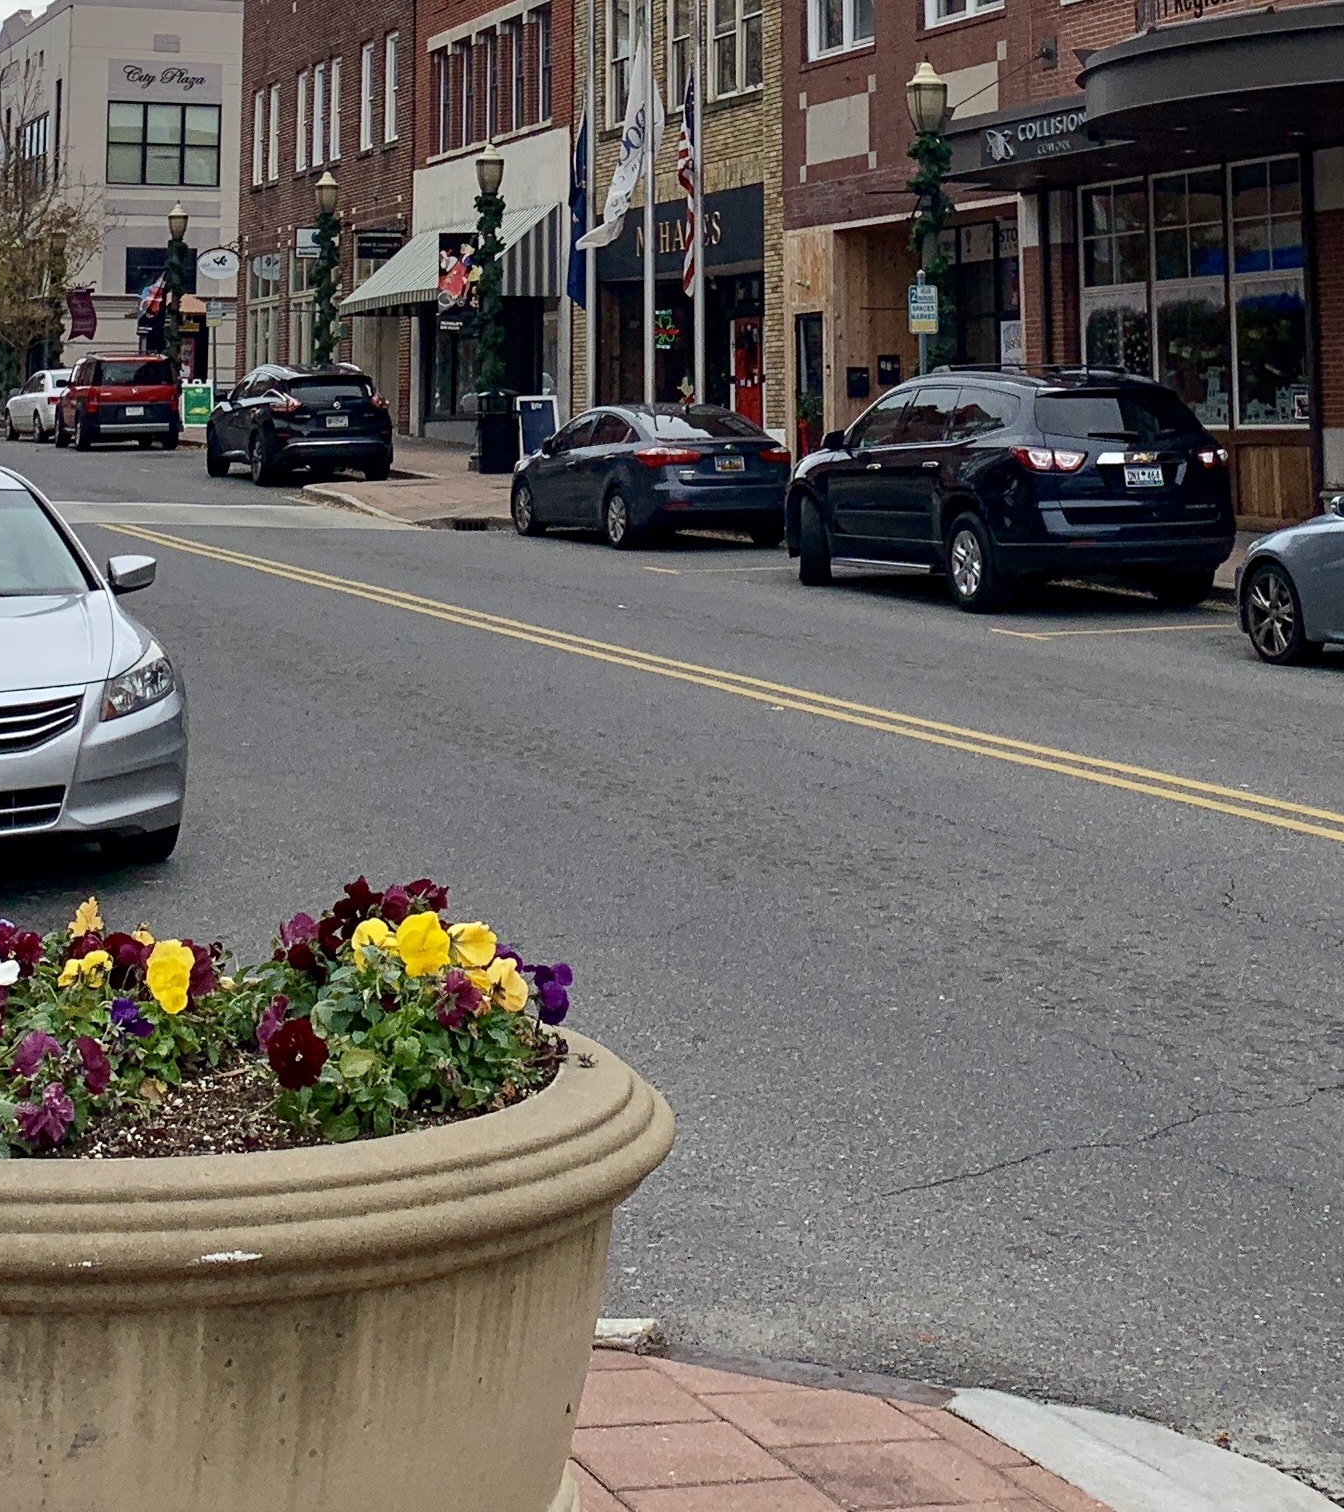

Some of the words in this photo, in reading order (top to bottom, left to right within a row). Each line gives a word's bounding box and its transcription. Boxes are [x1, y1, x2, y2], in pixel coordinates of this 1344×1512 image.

[123, 65, 156, 89] City
[160, 67, 206, 91] Plaza
[1017, 112, 1087, 141] COLLISION
